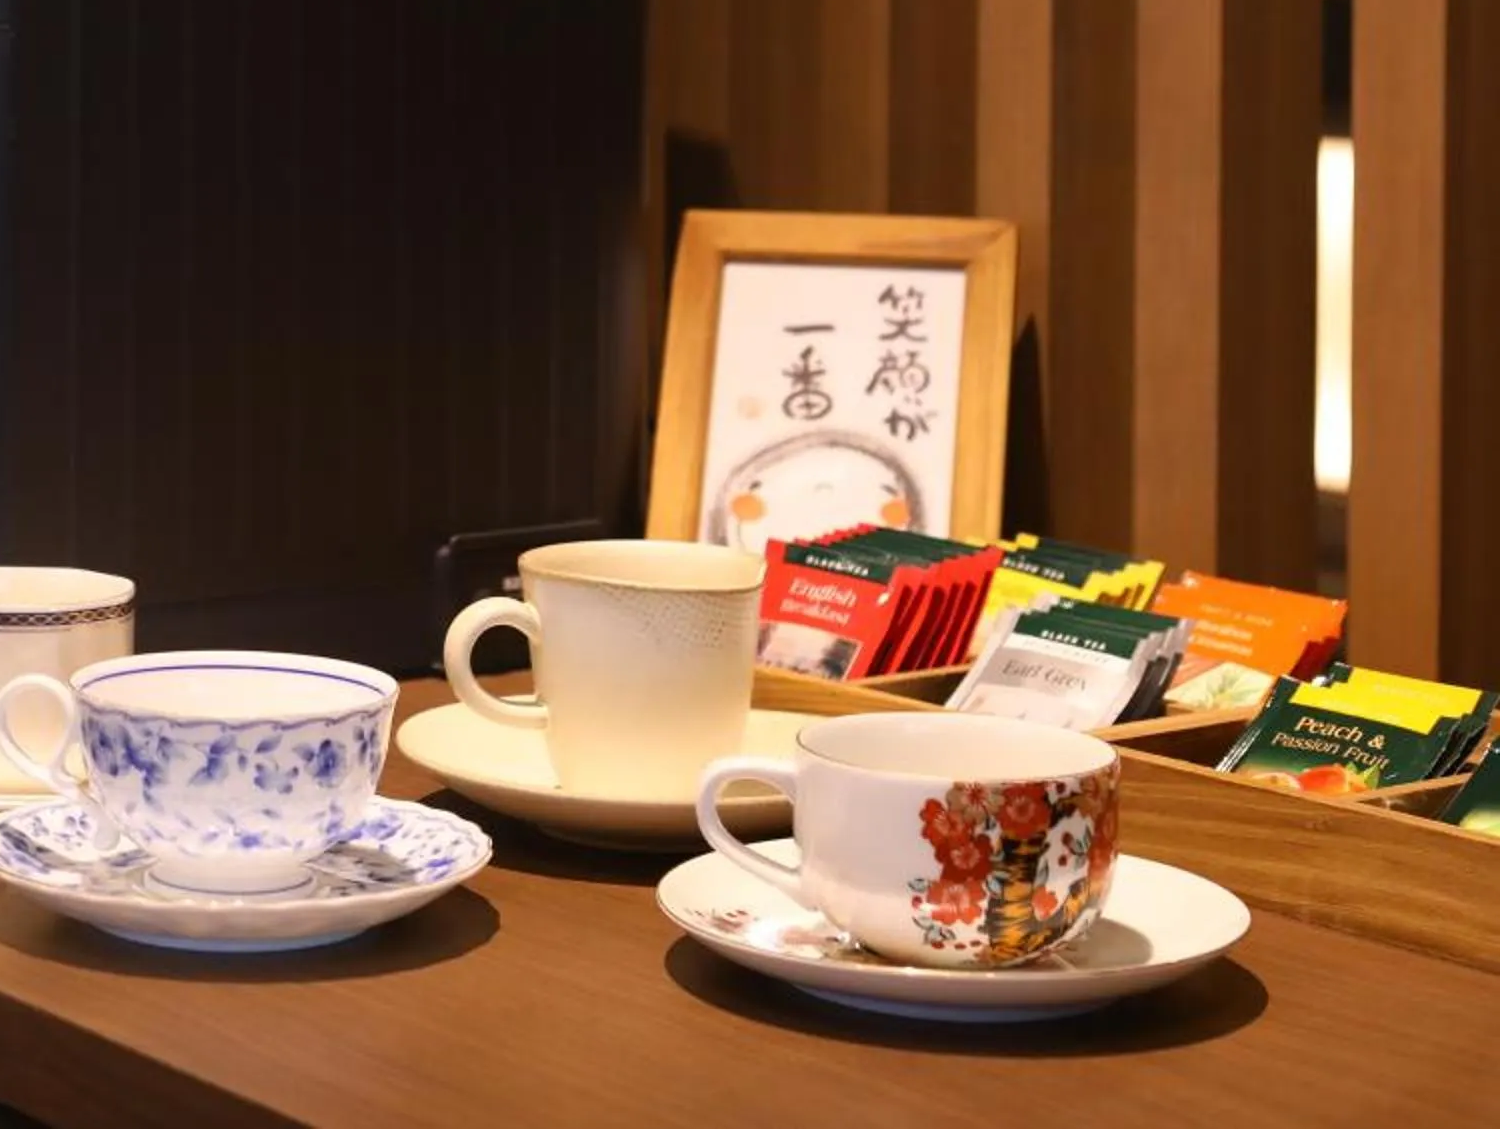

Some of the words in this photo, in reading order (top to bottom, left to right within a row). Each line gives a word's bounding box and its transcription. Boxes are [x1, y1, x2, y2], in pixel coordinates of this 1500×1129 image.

[782, 324, 836, 421] 一番
[866, 284, 938, 442] 笑顔が
[788, 577, 857, 609] English
[1040, 629, 1079, 645] BLACK
[1083, 638, 1107, 652] TEA
[1271, 731, 1341, 756] Passion
[1343, 745, 1391, 771] Fruit
[1294, 716, 1363, 744] Peach
[1366, 733, 1386, 751] &
